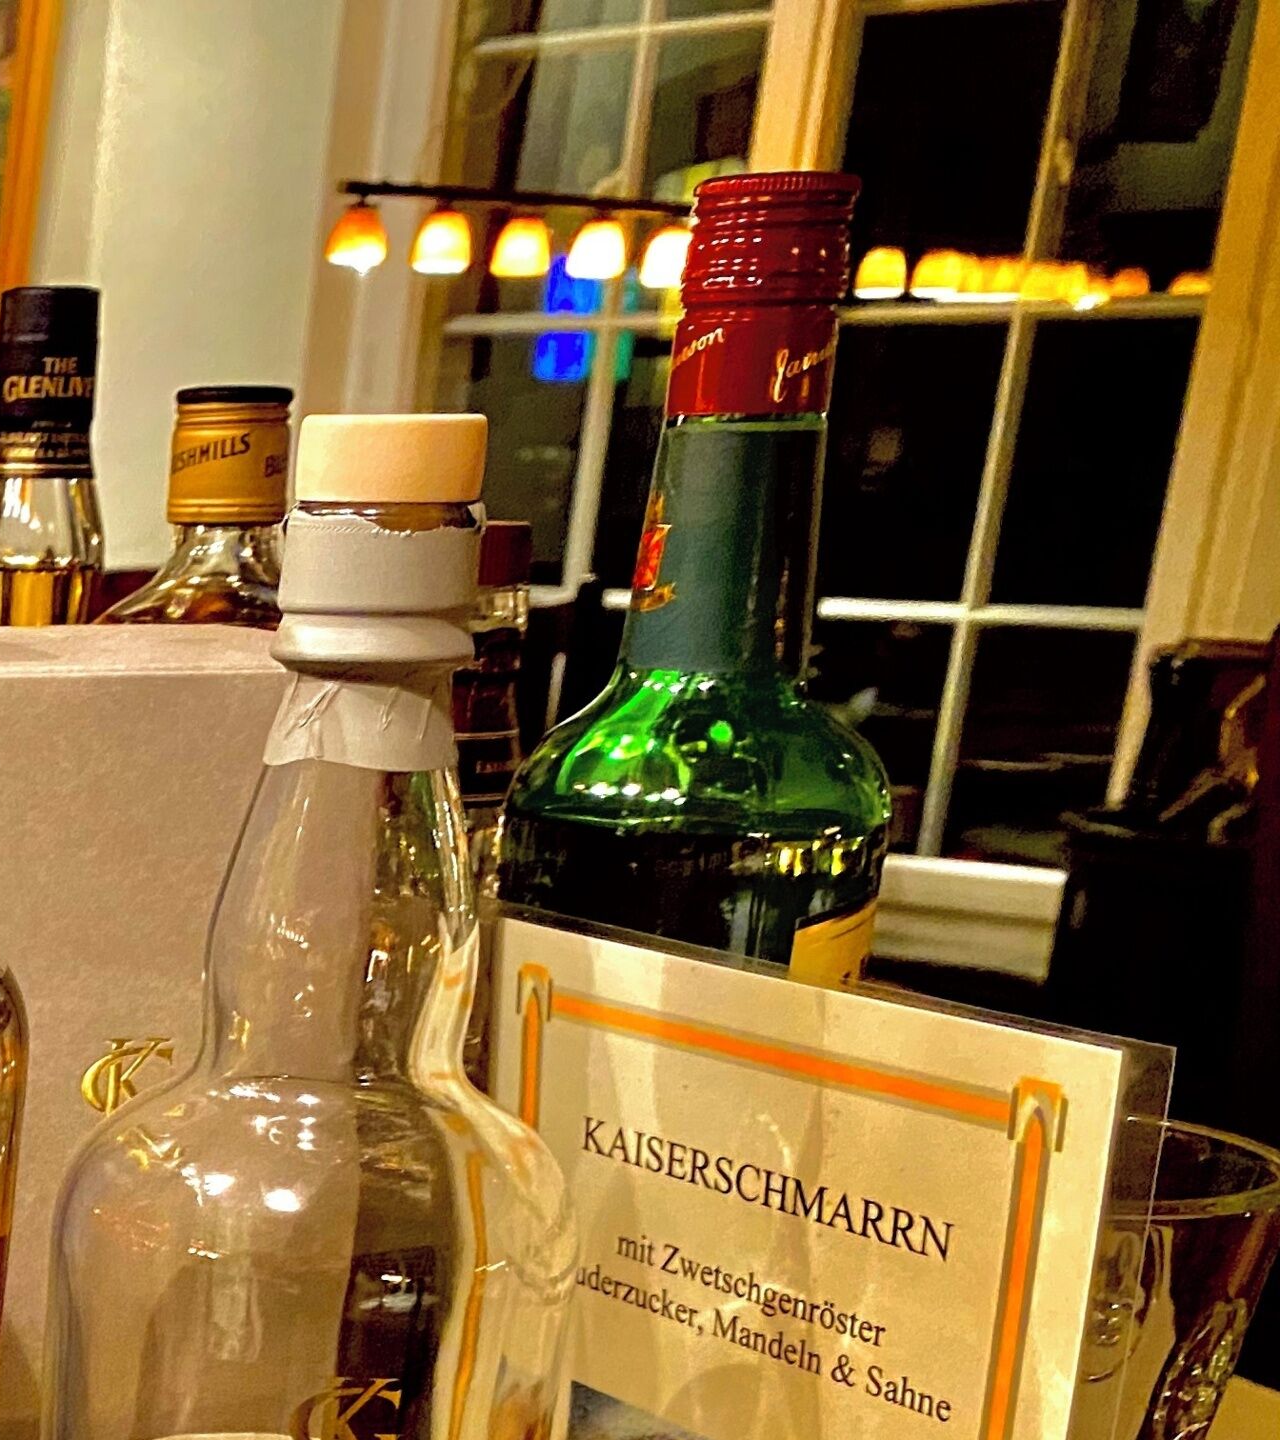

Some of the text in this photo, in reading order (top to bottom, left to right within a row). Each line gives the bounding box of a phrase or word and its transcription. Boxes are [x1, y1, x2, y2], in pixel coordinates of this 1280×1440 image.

[2, 375, 94, 403] GLENLIV
[42, 356, 78, 374] THE
[172, 432, 251, 475] SHMILLS
[581, 1116, 954, 1263] KAISERSCHMARRN
[616, 1232, 886, 1348] mit Zwetschgenröster
[576, 1264, 953, 1423] uderzucker, Mandeln & Sahne
